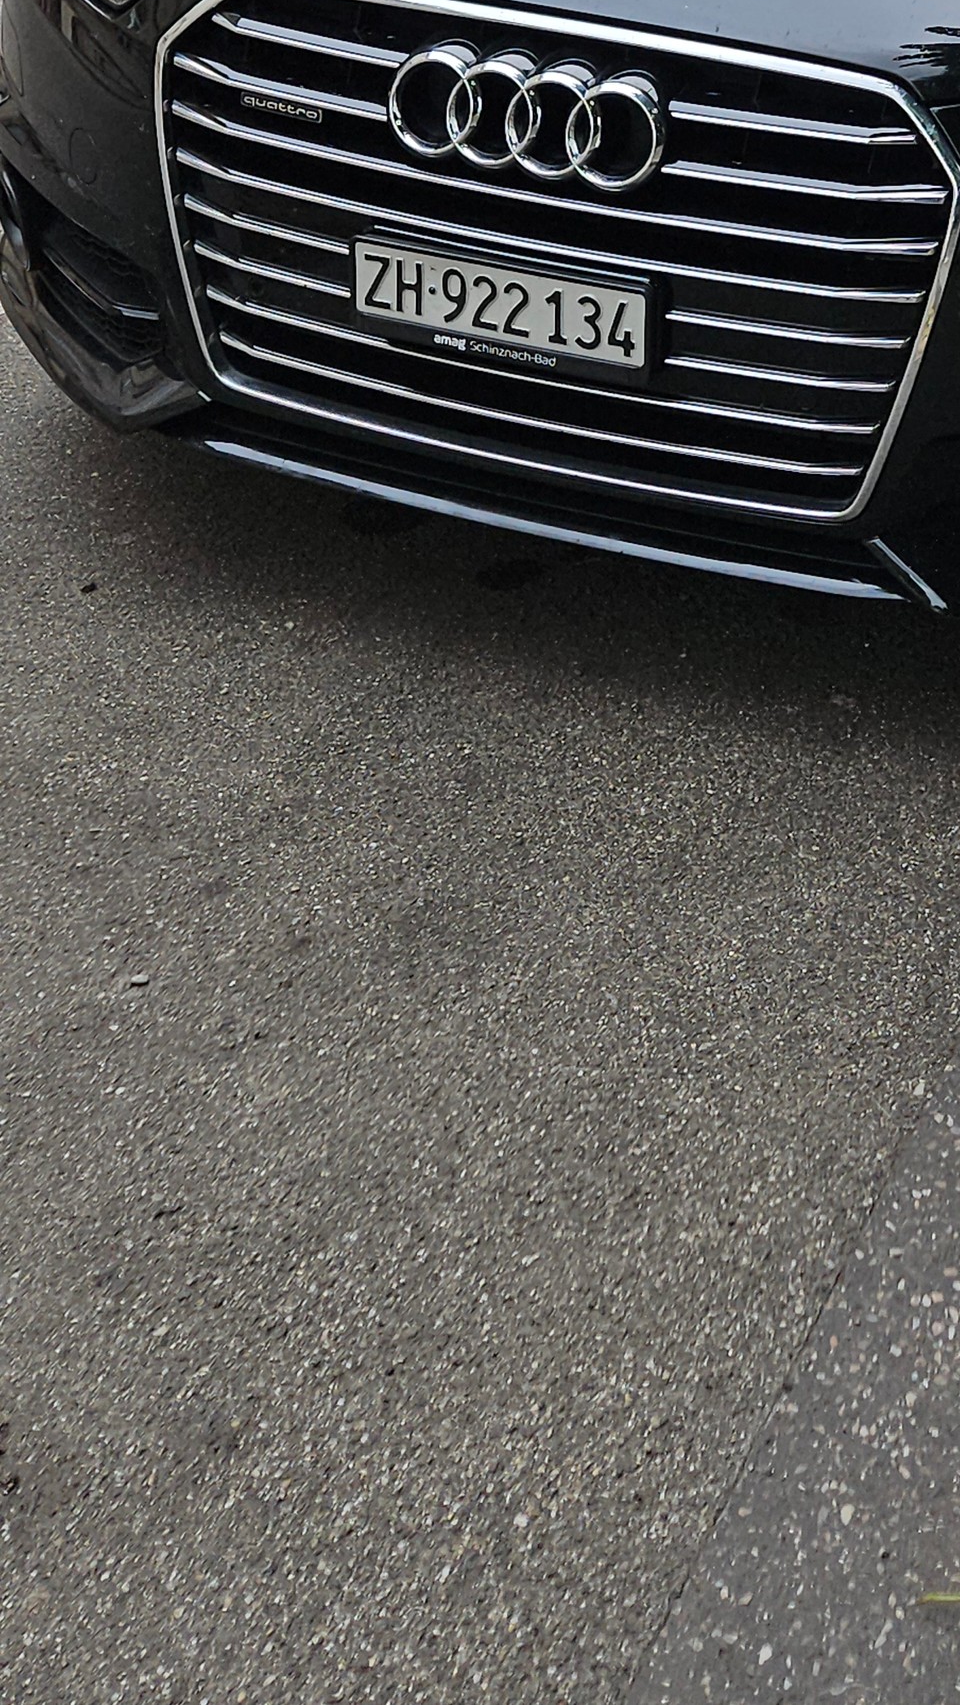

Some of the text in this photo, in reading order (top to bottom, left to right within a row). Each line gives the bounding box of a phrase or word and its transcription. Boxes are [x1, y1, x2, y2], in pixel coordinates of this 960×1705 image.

[243, 95, 318, 120] quattro
[433, 333, 556, 367] amag Schinznach-Bad
